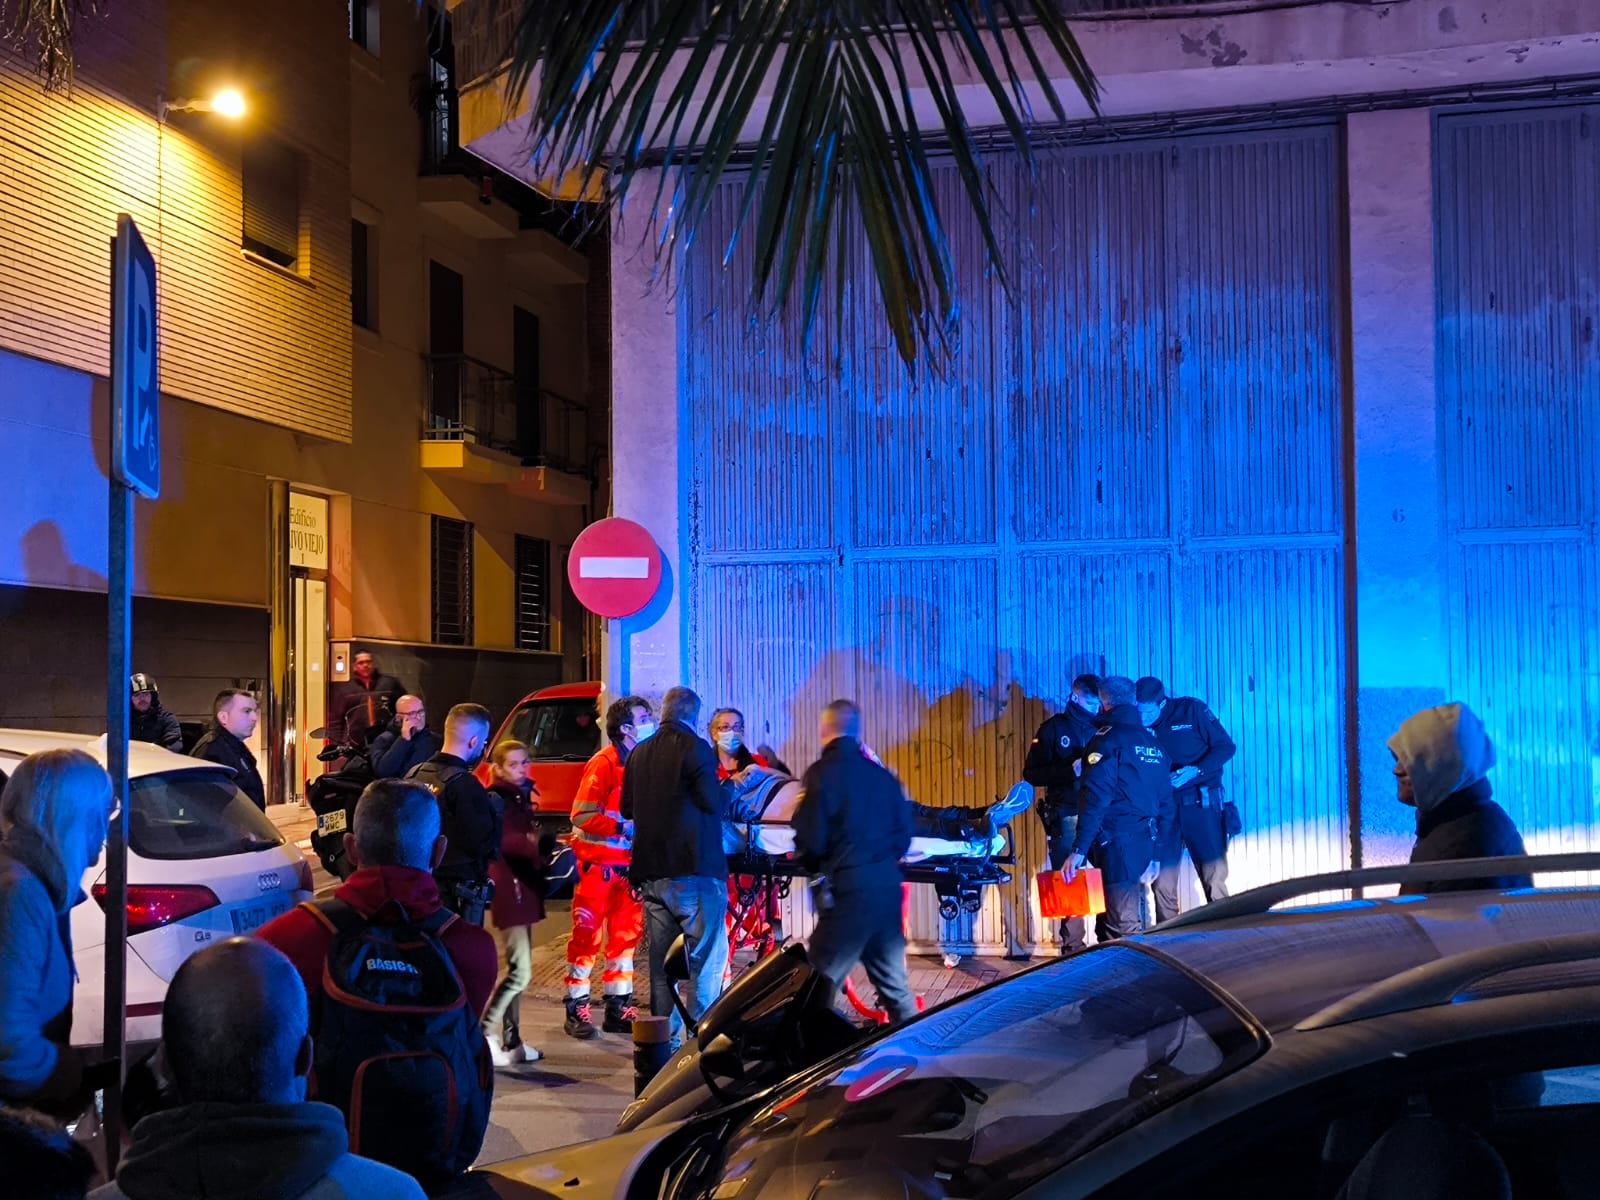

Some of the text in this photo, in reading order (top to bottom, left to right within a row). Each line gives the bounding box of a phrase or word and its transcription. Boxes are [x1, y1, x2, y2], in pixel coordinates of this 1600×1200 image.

[290, 507, 316, 528] Edificio
[1392, 508, 1405, 523] 6
[304, 533, 324, 555] VIEJO
